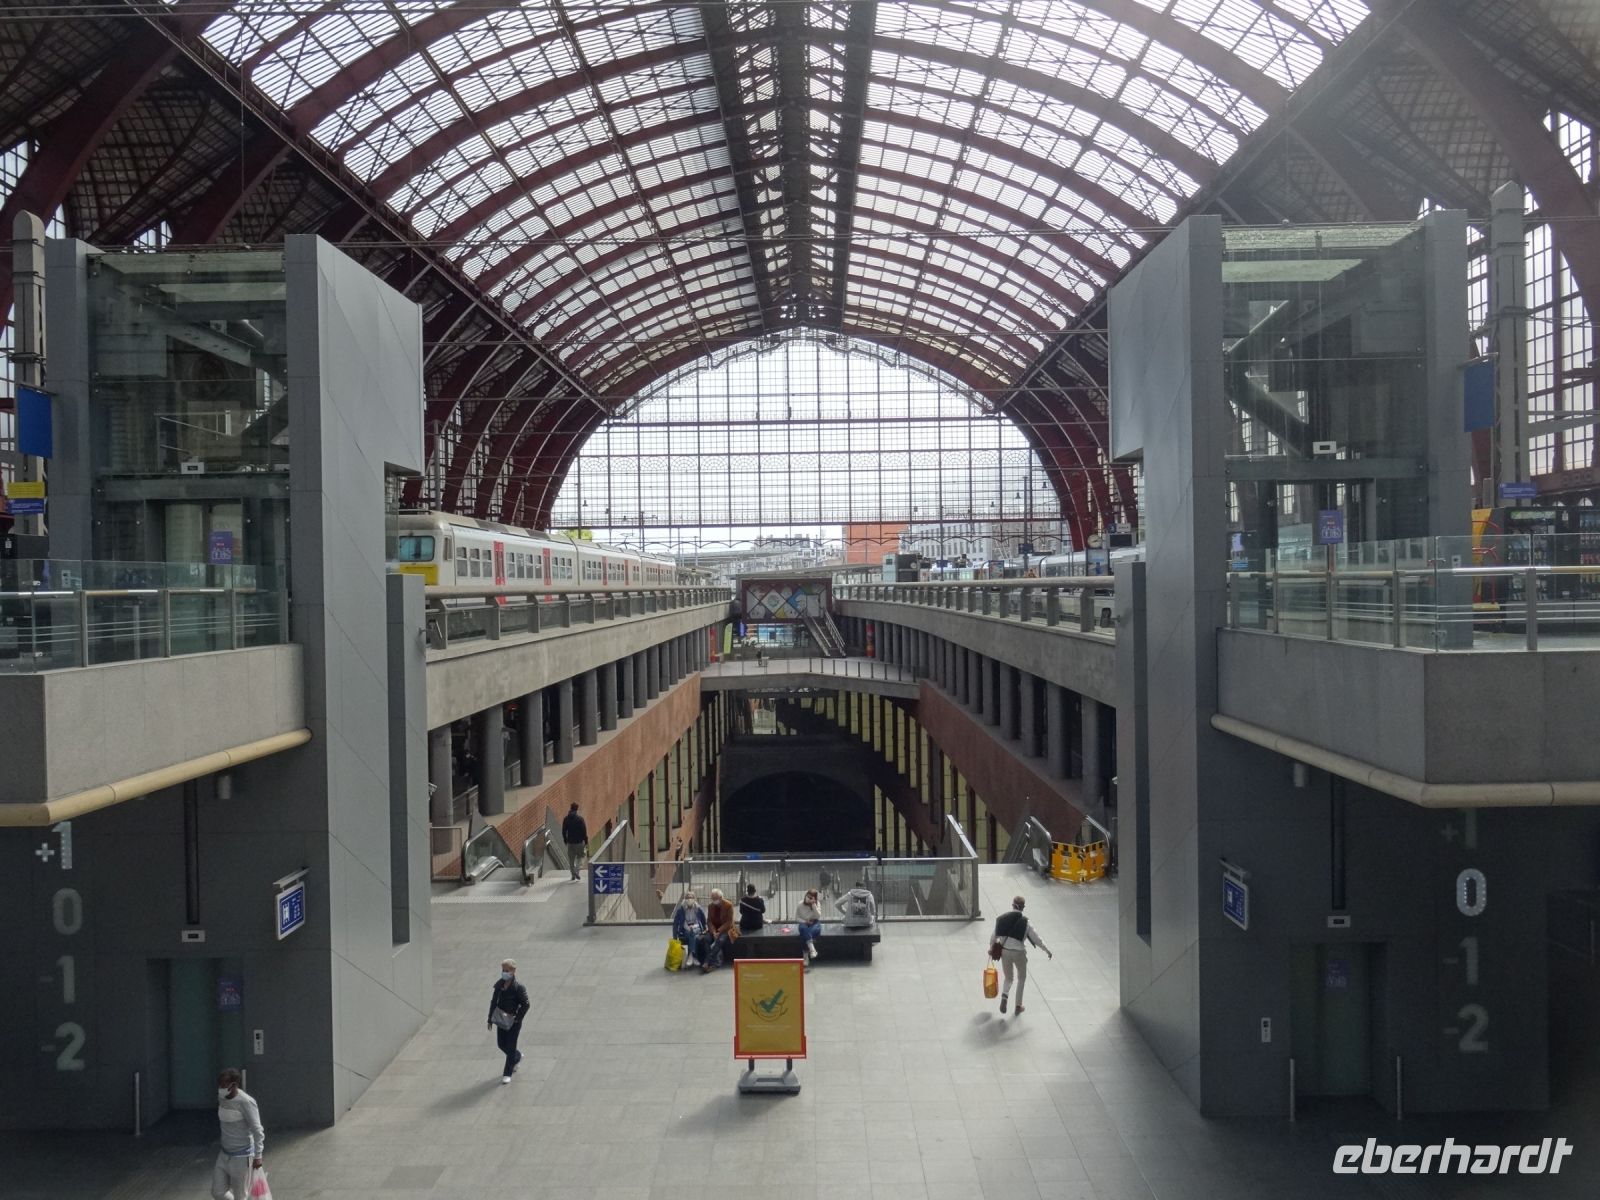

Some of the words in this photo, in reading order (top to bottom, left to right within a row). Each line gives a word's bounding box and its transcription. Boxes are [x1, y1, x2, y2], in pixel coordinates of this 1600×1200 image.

[35, 820, 74, 870] +1
[51, 887, 83, 936] 0
[1455, 867, 1488, 918] 0
[39, 955, 75, 1004] -1
[1442, 936, 1480, 986] -1
[40, 1021, 86, 1072] -2
[1442, 1003, 1489, 1054] -2
